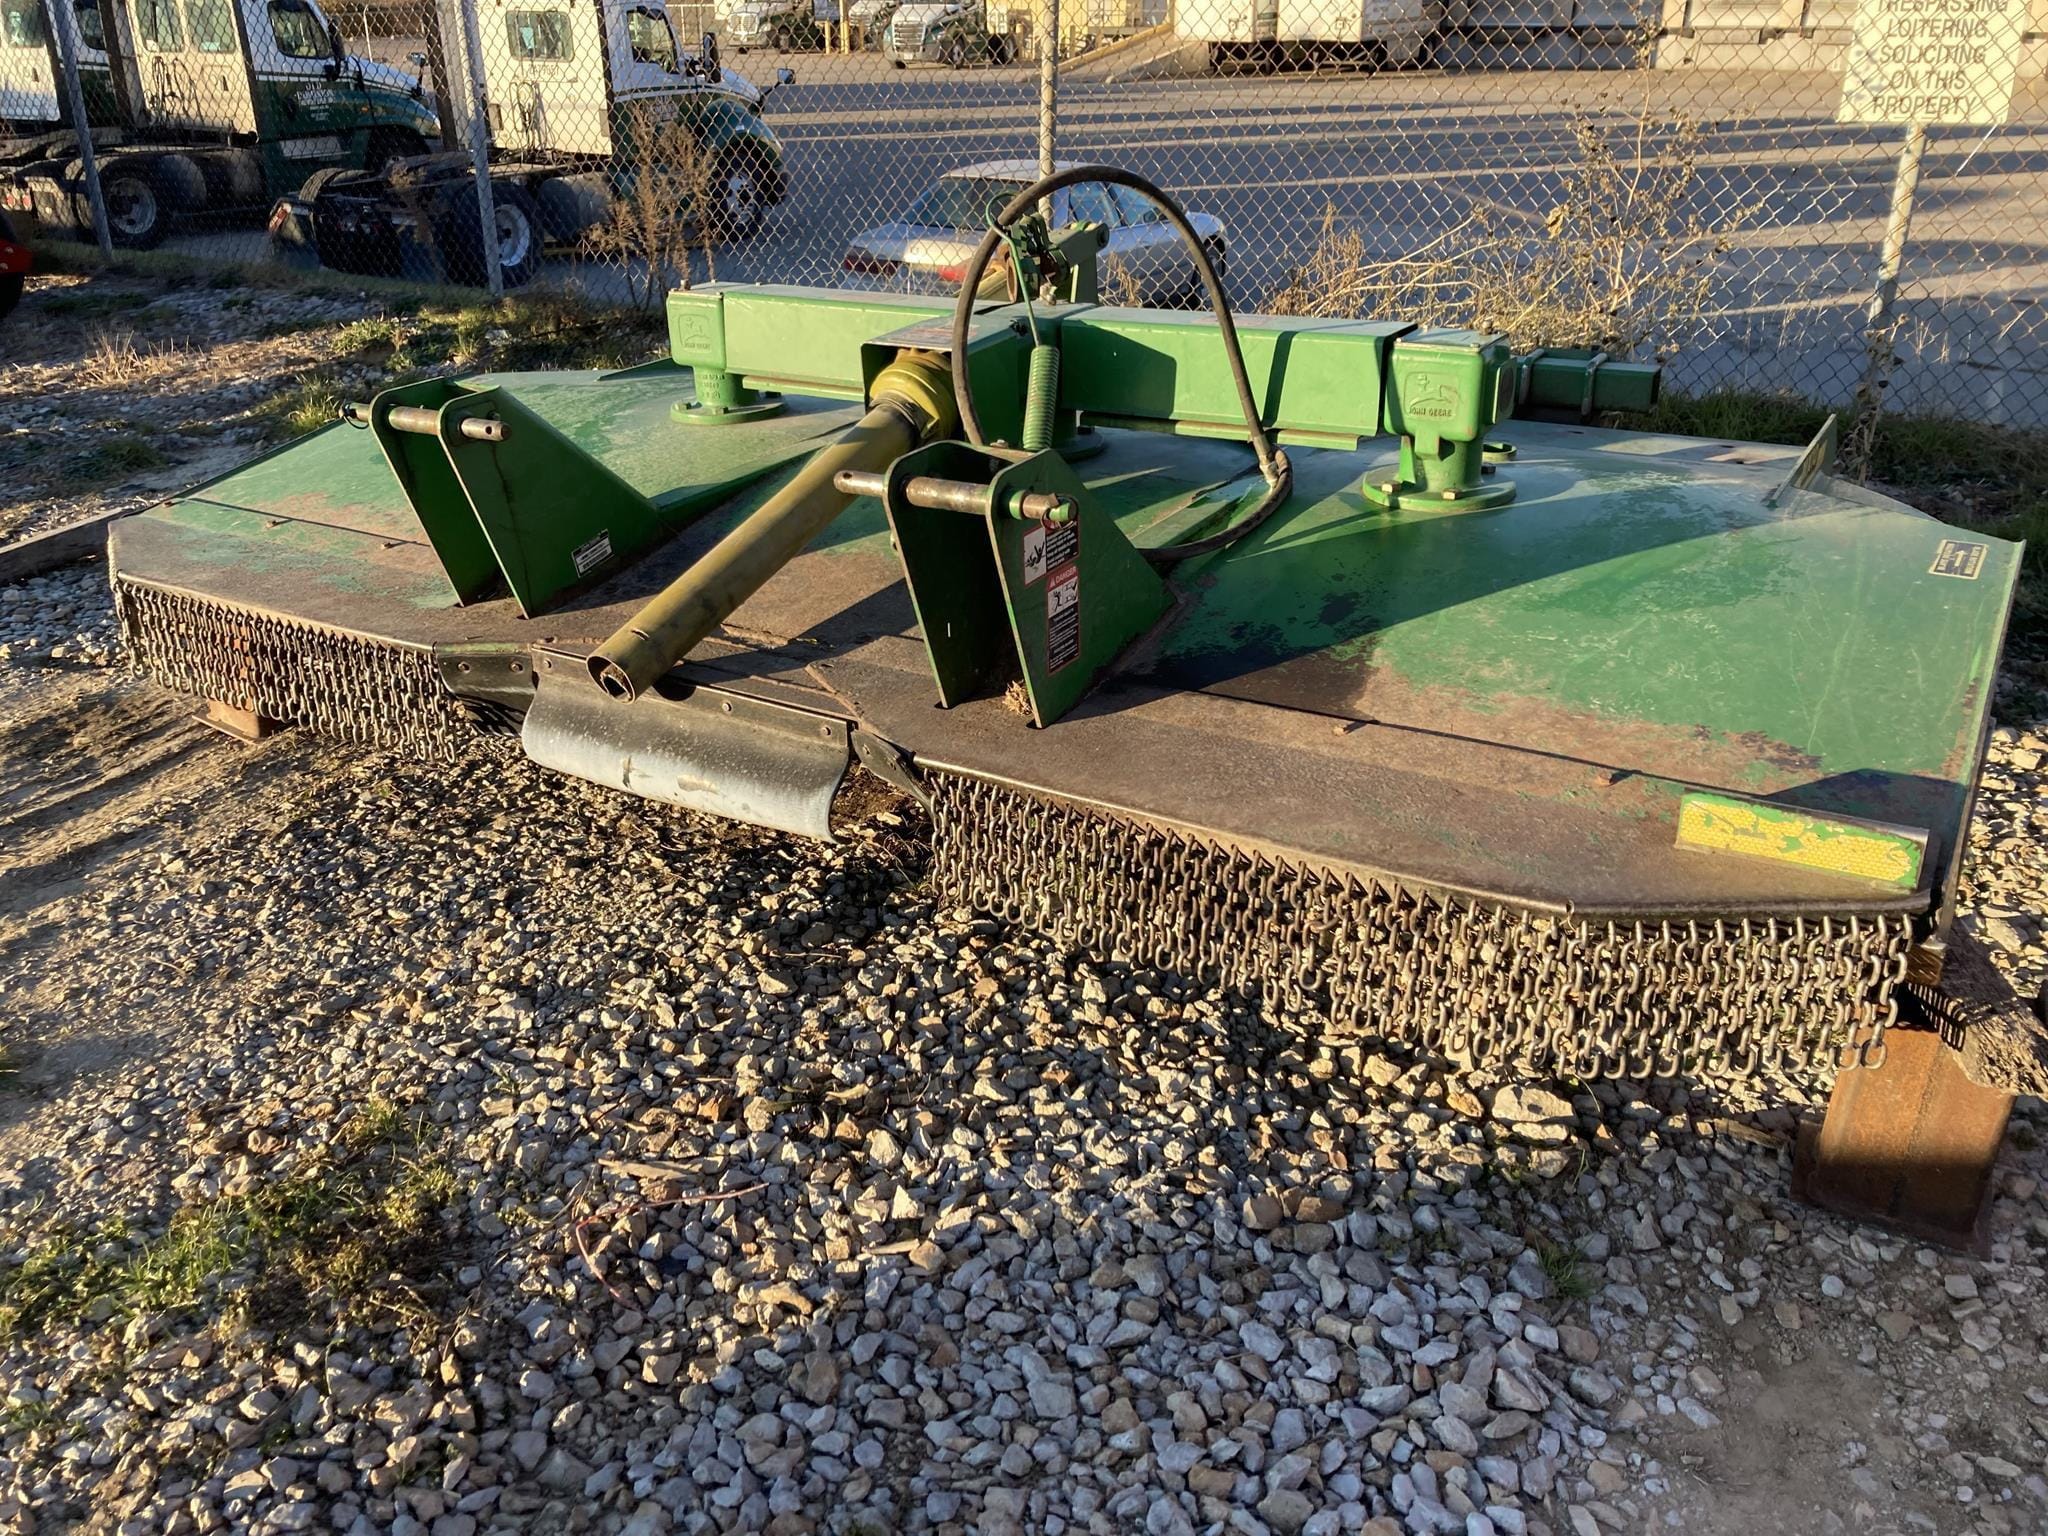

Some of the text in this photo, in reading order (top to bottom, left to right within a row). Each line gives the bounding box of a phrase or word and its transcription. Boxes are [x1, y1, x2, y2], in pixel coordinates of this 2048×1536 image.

[1878, 0, 2008, 13] TRESPASSING
[1888, 18, 1989, 38] LOITERING
[1879, 45, 1987, 64] SOLICITING
[1891, 70, 1967, 90] ON THIS
[1872, 95, 1978, 115] PROPERTY
